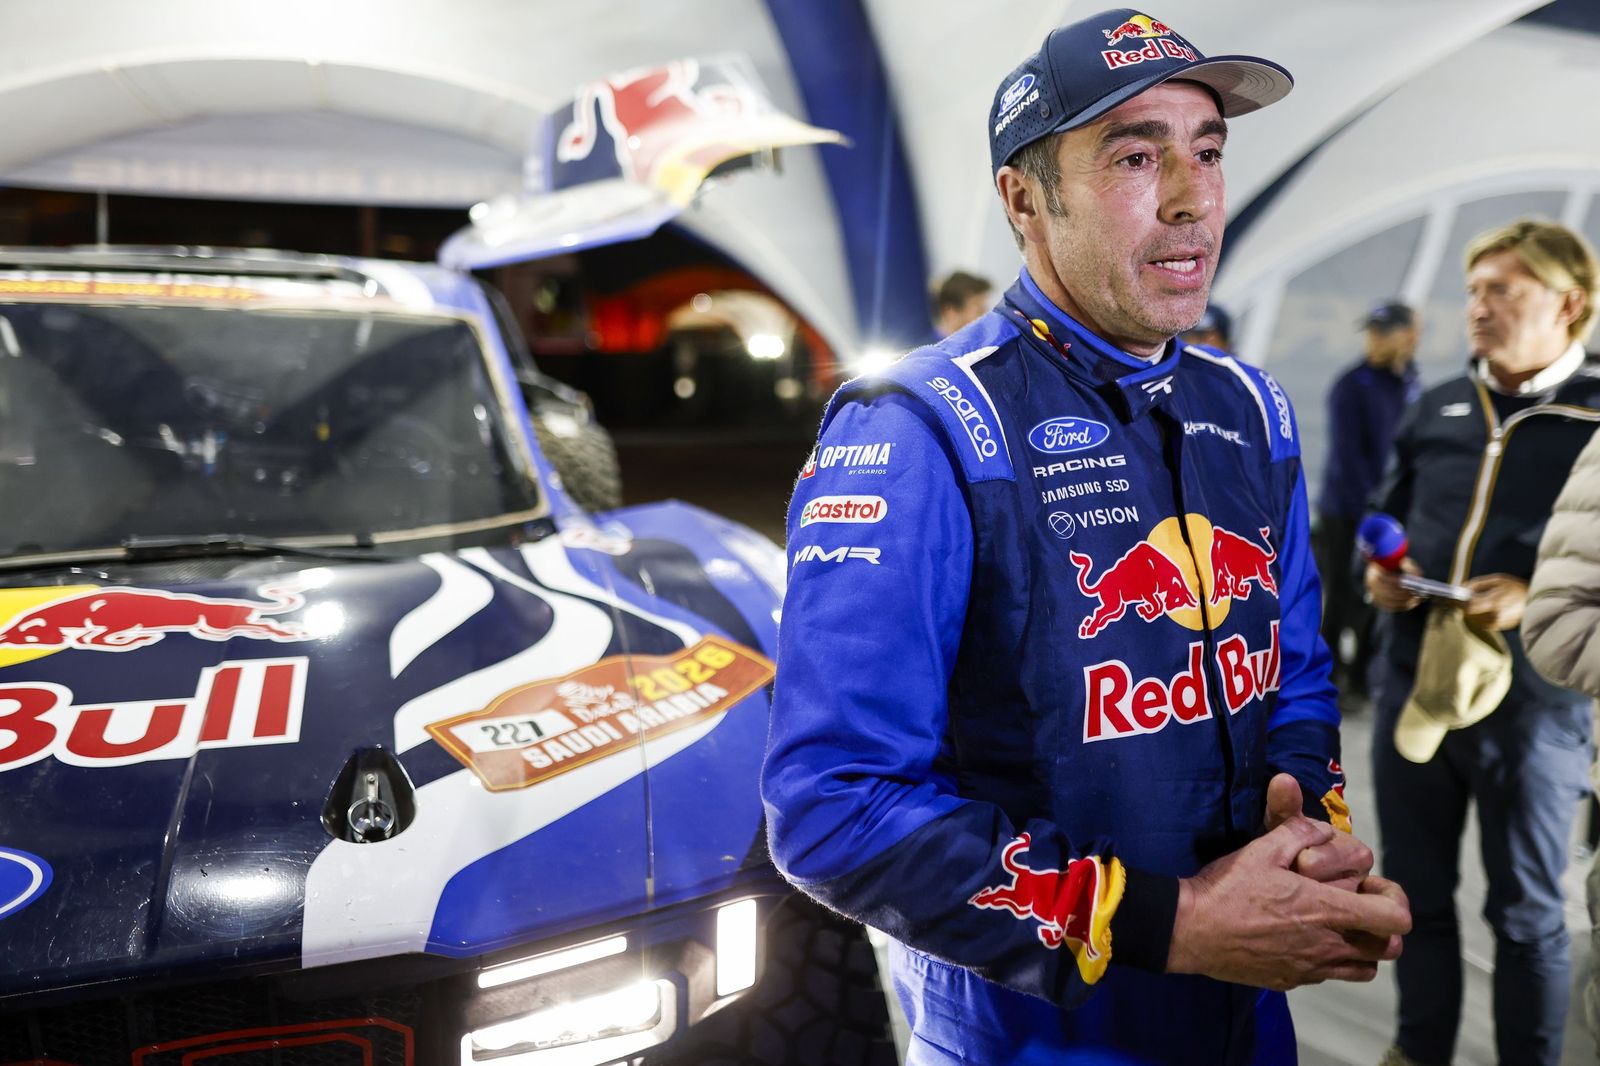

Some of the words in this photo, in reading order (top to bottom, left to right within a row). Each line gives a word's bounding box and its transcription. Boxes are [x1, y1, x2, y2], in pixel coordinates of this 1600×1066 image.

[1101, 38, 1162, 70] Red
[1160, 39, 1199, 62] Bul
[995, 89, 1039, 135] RACING
[926, 376, 998, 463] sparco
[1043, 421, 1092, 449] Ford
[820, 442, 891, 469] OPTIMA
[1032, 454, 1127, 478] RACING
[1042, 481, 1102, 504] SAMSUNG
[1105, 479, 1130, 493] SSD
[810, 500, 881, 520] Castrol
[1075, 506, 1140, 529] VISION
[792, 545, 882, 568] MMR
[632, 643, 736, 701] 2026
[1083, 640, 1213, 743] Red
[1215, 619, 1280, 715] Bul
[481, 719, 544, 747] 227
[520, 719, 622, 769] SAUDI
[618, 681, 729, 733] ARABIA
